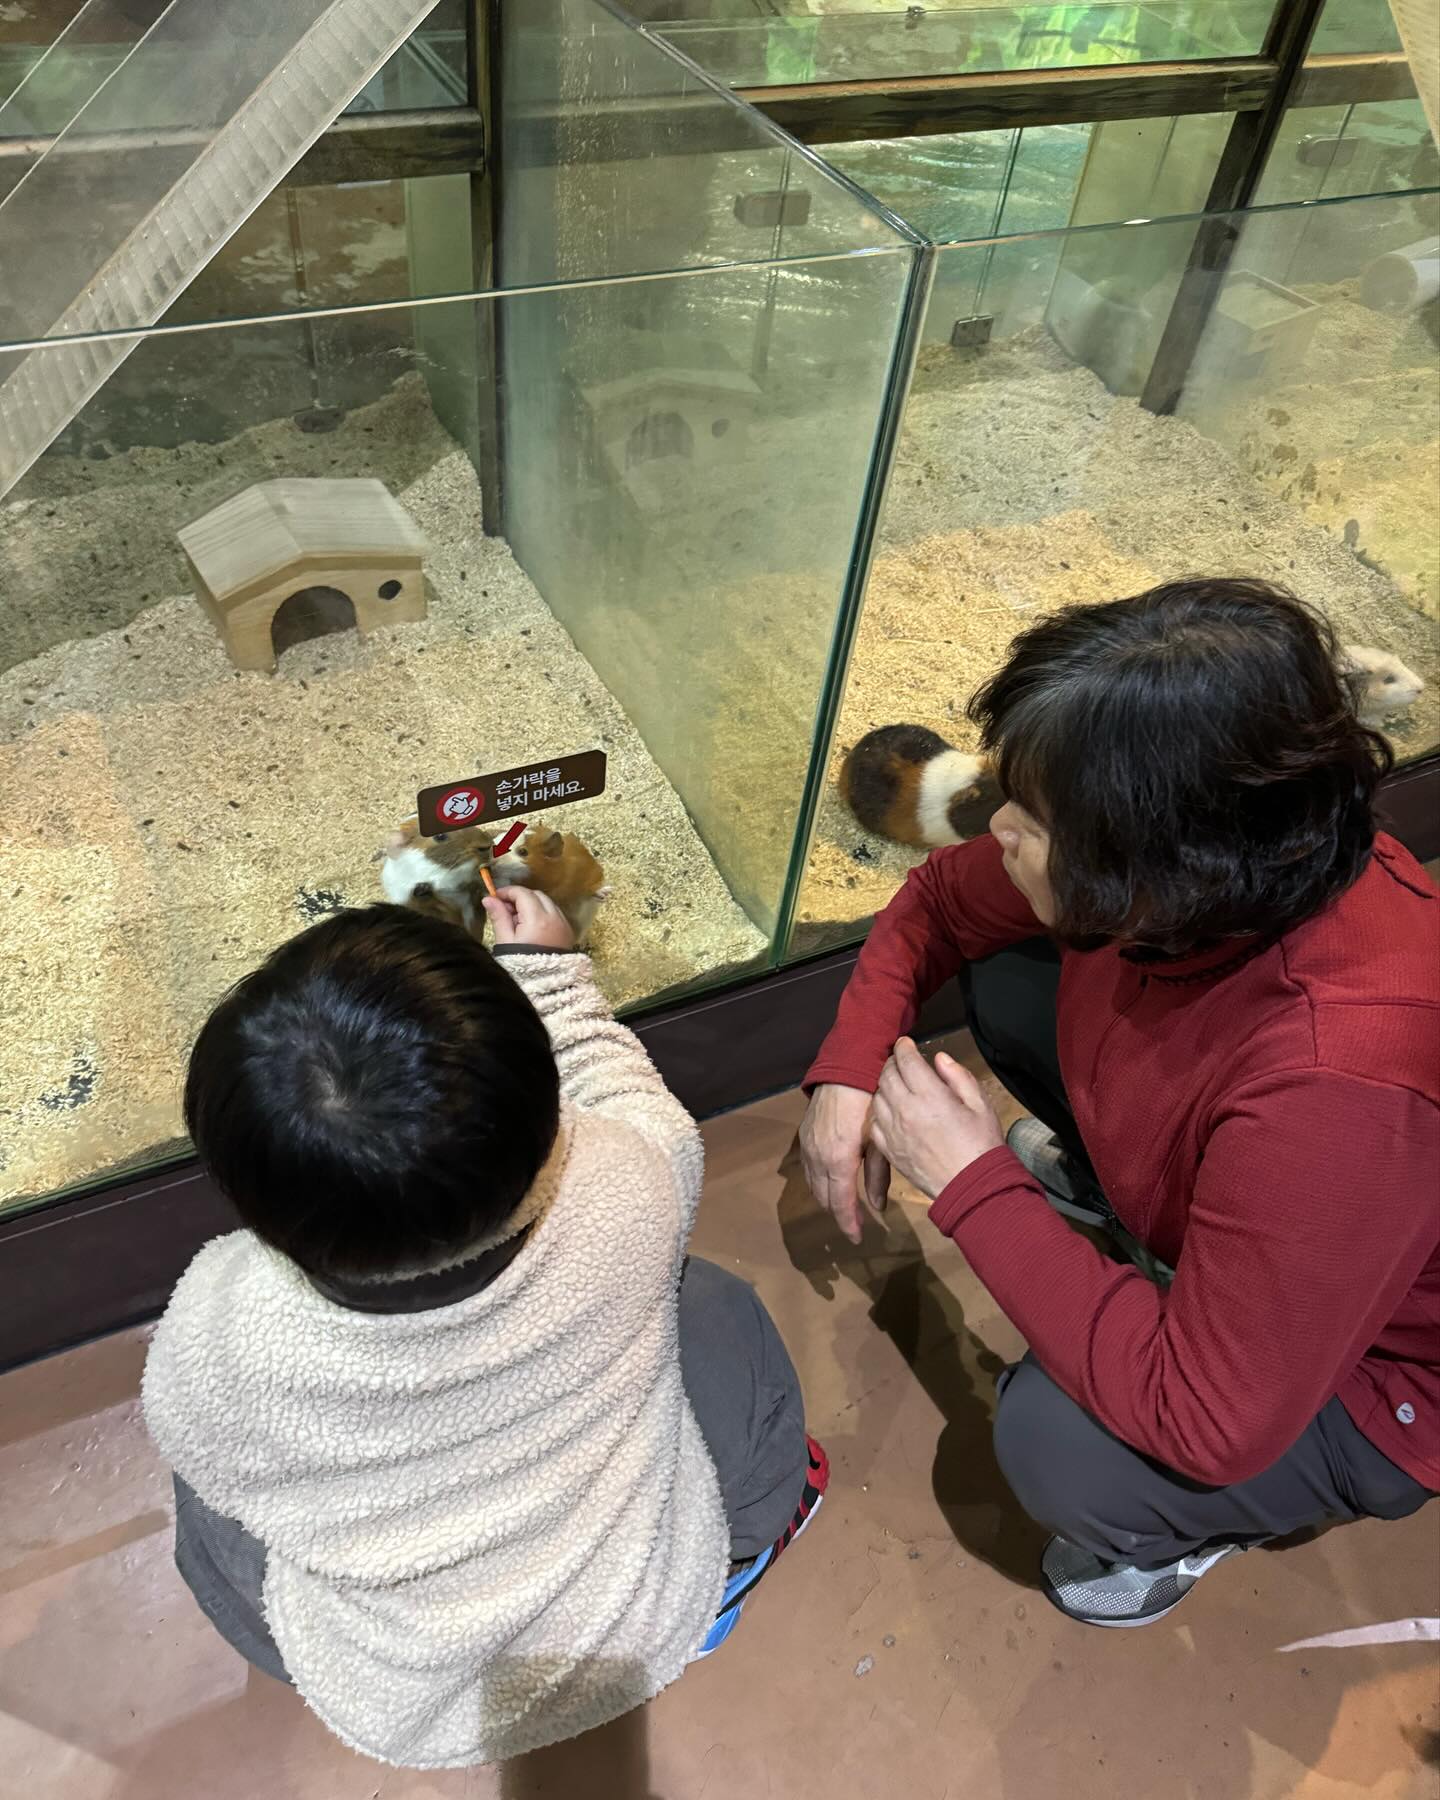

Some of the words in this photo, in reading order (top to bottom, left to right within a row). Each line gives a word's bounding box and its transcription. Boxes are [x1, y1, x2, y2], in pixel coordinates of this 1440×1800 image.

[495, 767, 562, 795] 손가락을
[496, 792, 529, 812] 넣지
[533, 780, 585, 802] 마세요.
